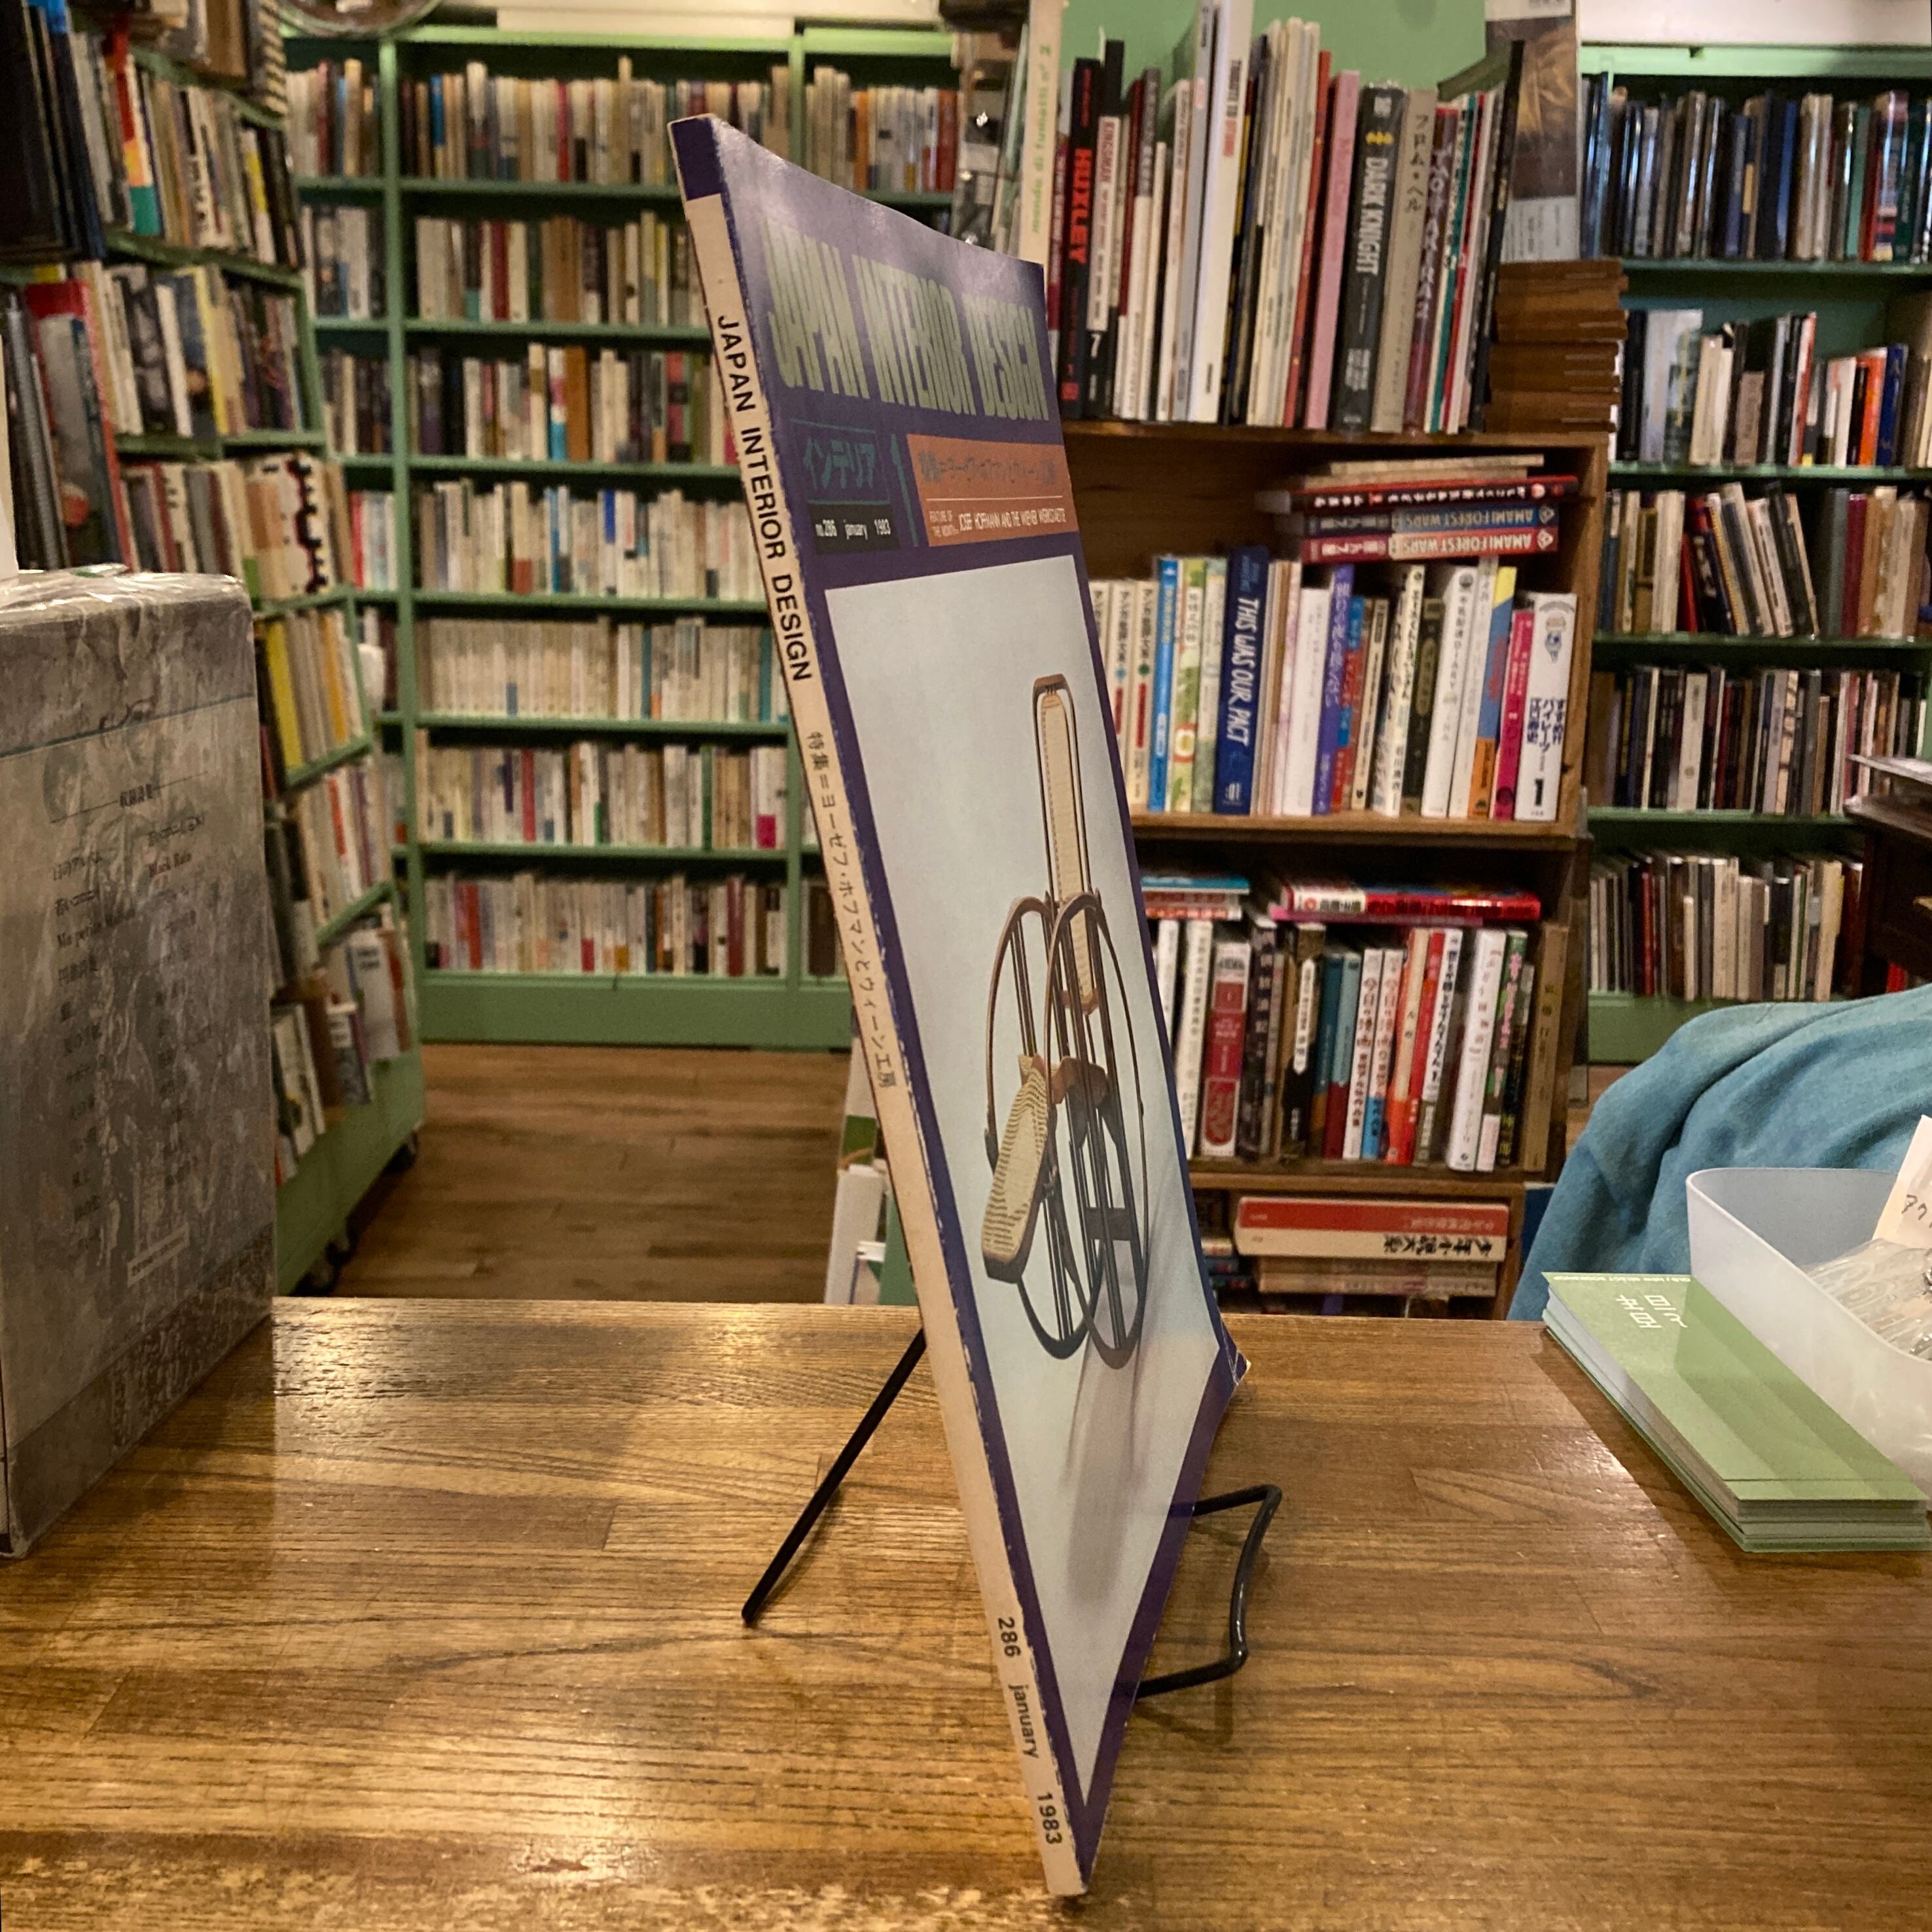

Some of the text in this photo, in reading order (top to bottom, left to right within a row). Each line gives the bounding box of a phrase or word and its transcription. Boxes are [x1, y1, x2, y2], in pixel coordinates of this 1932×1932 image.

[1069, 148, 1092, 265] HUXLEY
[1355, 156, 1388, 276] DARK KNIGHT
[760, 212, 870, 399] JAPAN
[852, 254, 976, 416] INTERIOR
[961, 293, 1049, 420] DESIGN
[717, 315, 812, 681] JAPAN INTERIOR DESIGN
[874, 518, 891, 535] 1983
[1406, 514, 1440, 528] WARS
[1444, 510, 1489, 527] FOREST
[1403, 539, 1438, 554] WARS
[1441, 536, 1488, 552] FOREST
[1235, 596, 1261, 633] THIS
[1231, 634, 1257, 670] WAS
[1228, 670, 1255, 705] OUR
[1226, 710, 1252, 747] PACT
[1616, 1295, 1662, 1328] 百年
[998, 1616, 1020, 1658] 286
[1008, 1683, 1040, 1759] january
[1037, 1793, 1062, 1845] 1983
